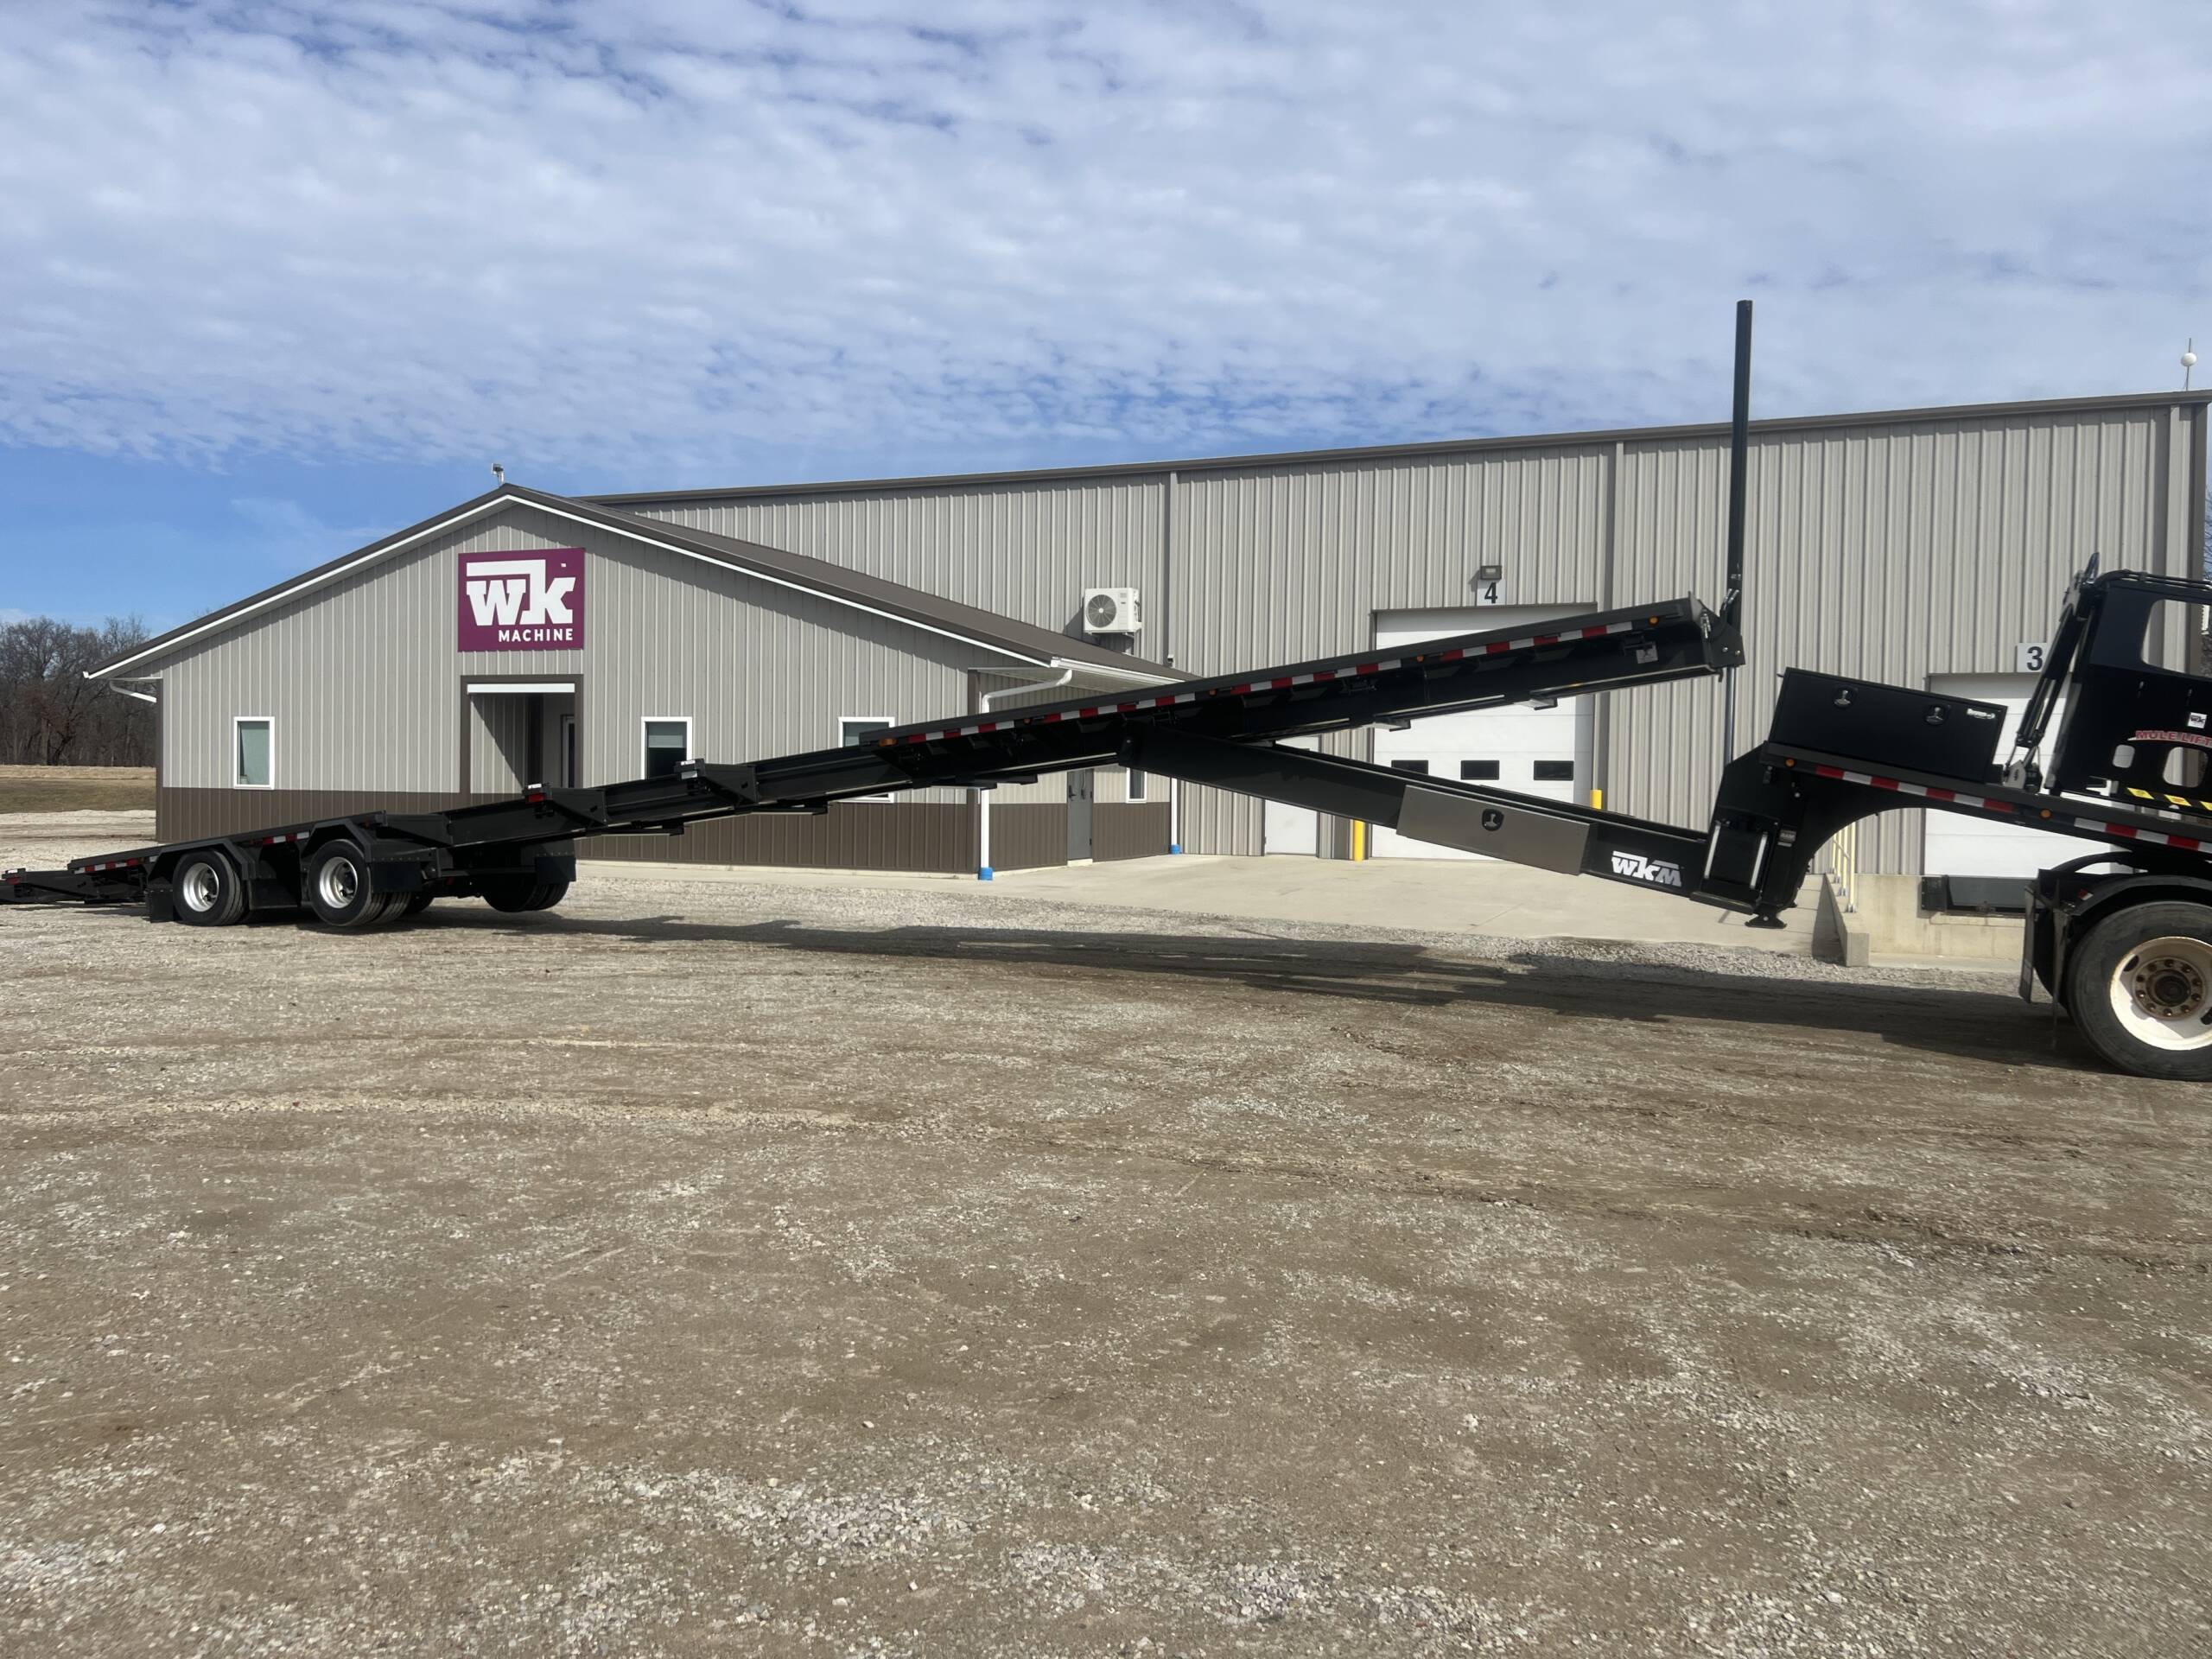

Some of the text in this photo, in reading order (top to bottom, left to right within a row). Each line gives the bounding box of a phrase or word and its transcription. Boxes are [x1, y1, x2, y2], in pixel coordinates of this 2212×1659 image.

[1484, 582, 1498, 604] 4
[499, 628, 573, 642] MACHINE
[2027, 646, 2043, 671] 3
[2181, 733, 2212, 747] LIFT
